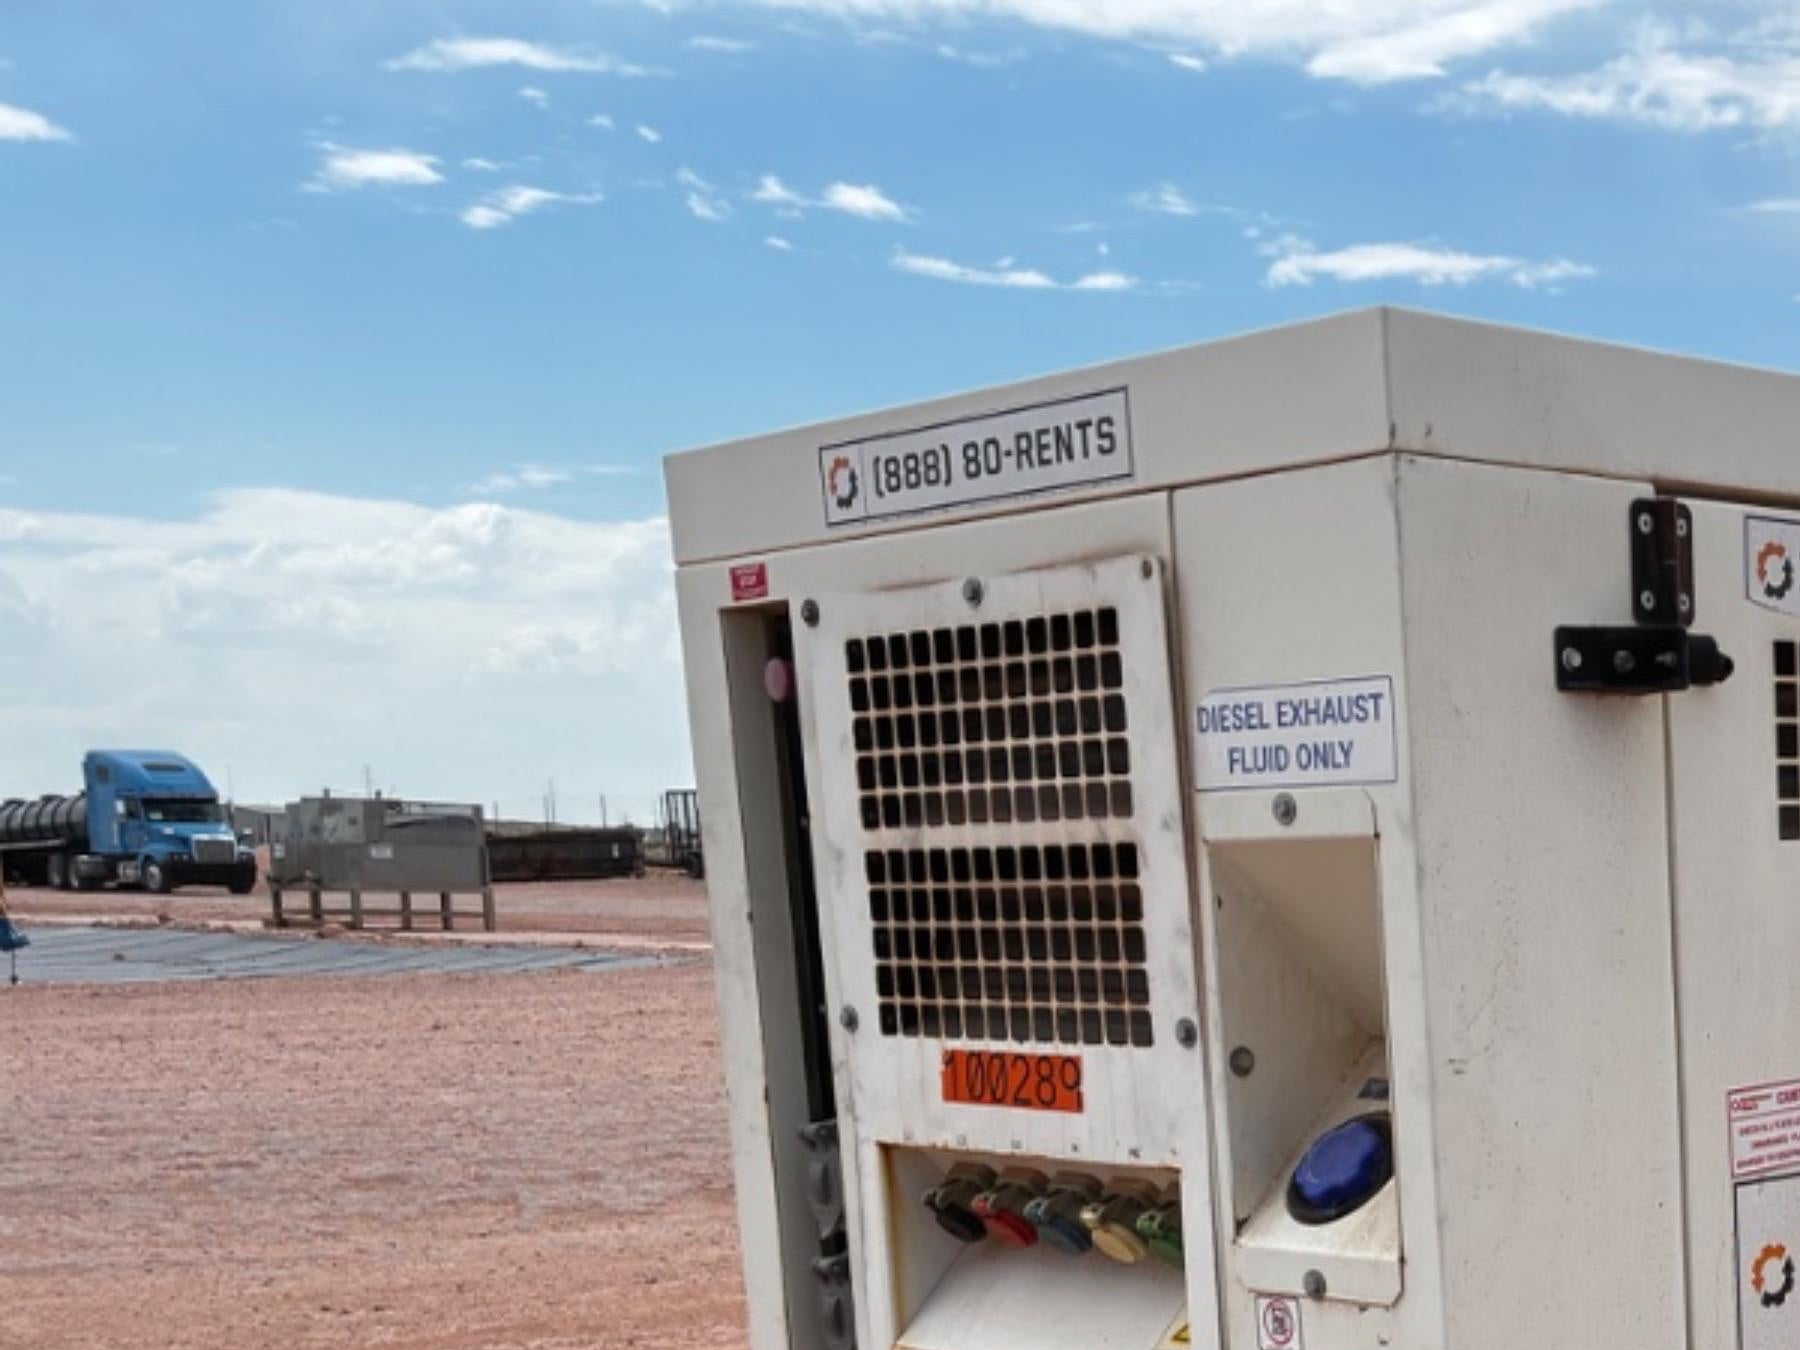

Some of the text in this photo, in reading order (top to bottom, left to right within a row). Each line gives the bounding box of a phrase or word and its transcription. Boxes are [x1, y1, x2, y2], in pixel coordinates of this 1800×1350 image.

[873, 416, 1117, 498] (888) 80-RENTS
[1196, 692, 1384, 733] DIESEL EXHAUST
[1227, 740, 1354, 774] FLUID ONLY
[943, 1049, 1083, 1113] 100289
